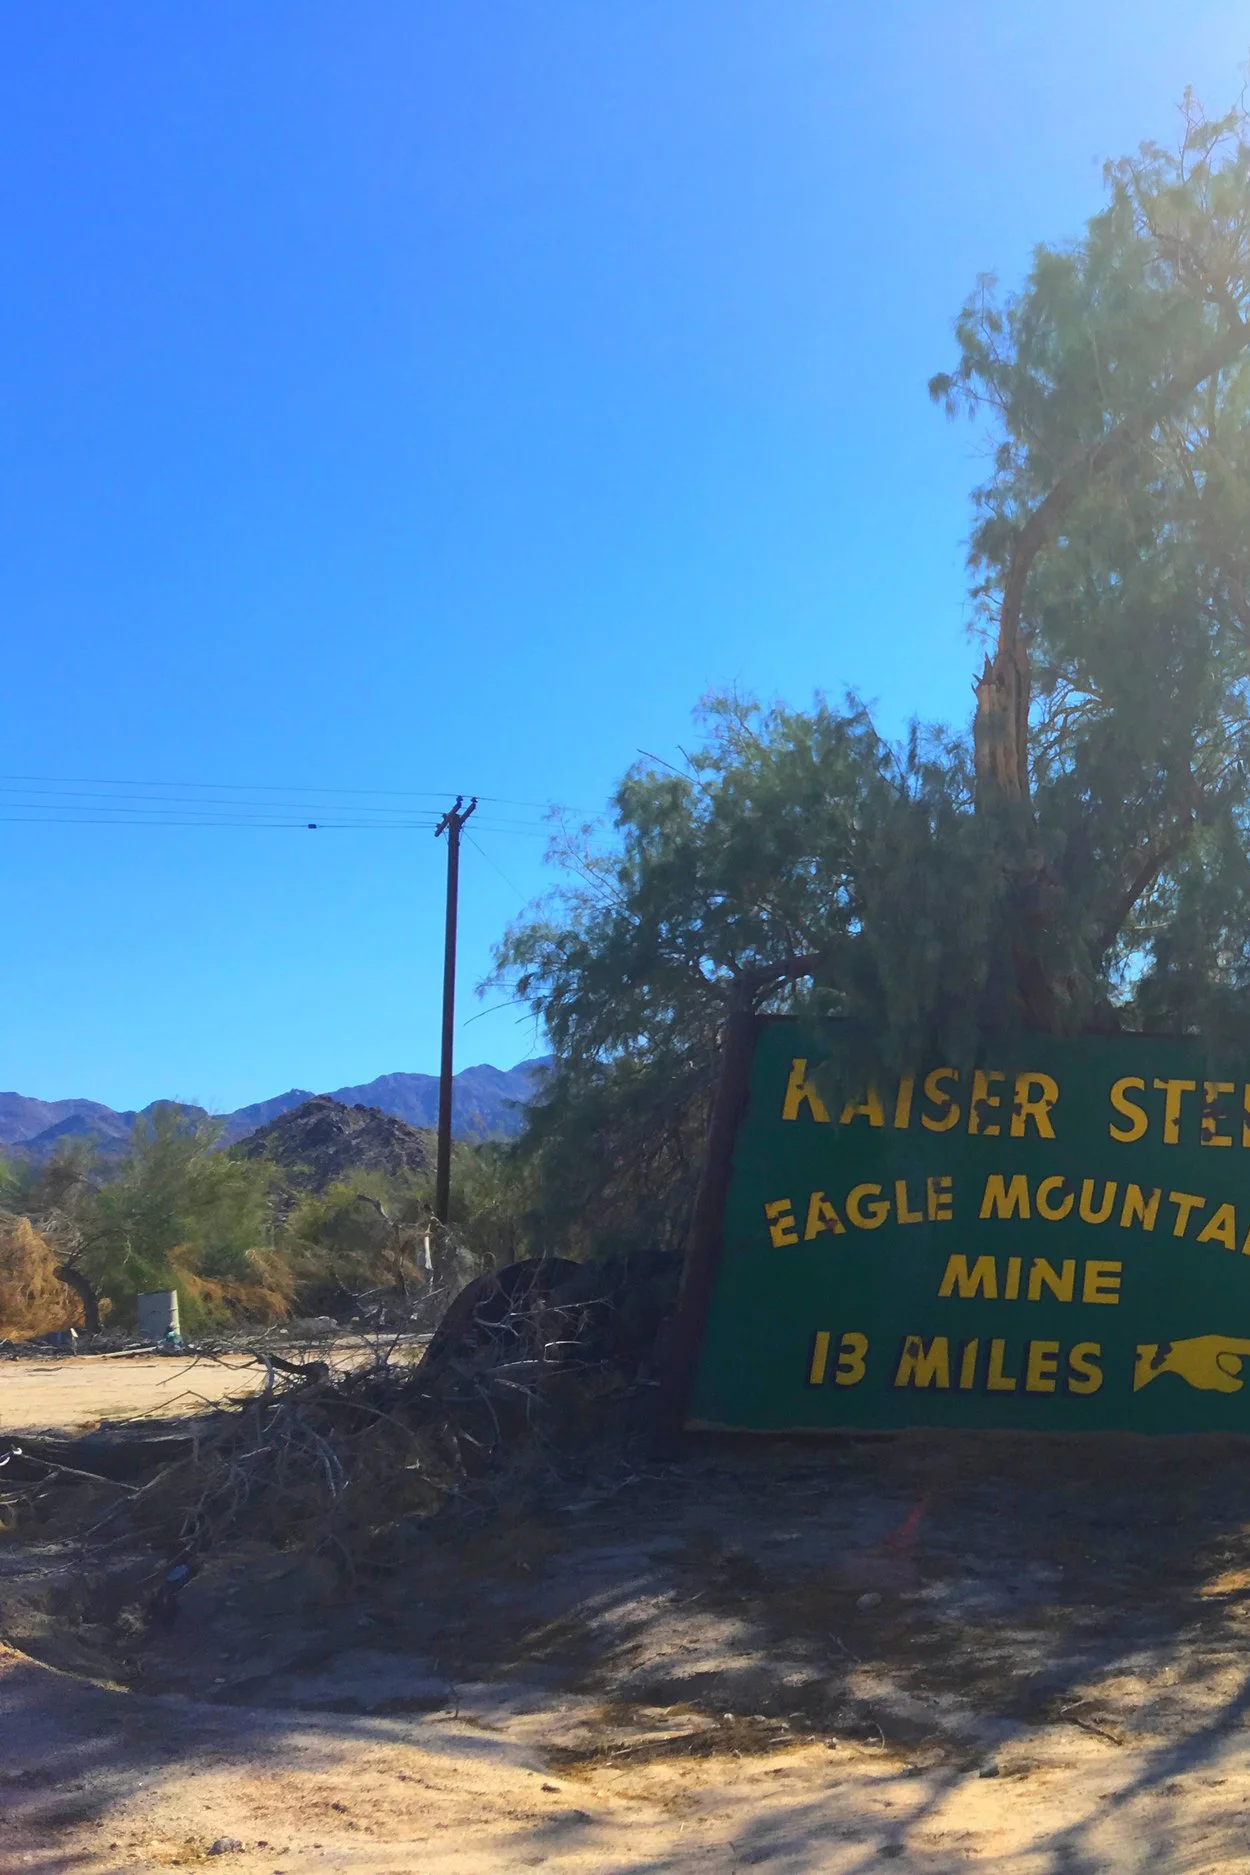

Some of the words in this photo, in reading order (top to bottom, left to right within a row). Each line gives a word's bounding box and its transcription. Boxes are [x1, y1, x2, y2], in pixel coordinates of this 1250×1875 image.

[782, 1058, 1060, 1139] KAISER
[765, 1176, 954, 1248] EAGLE
[937, 1254, 1123, 1304] MINE
[809, 1331, 869, 1386] 13
[894, 1335, 1103, 1394] MILES
